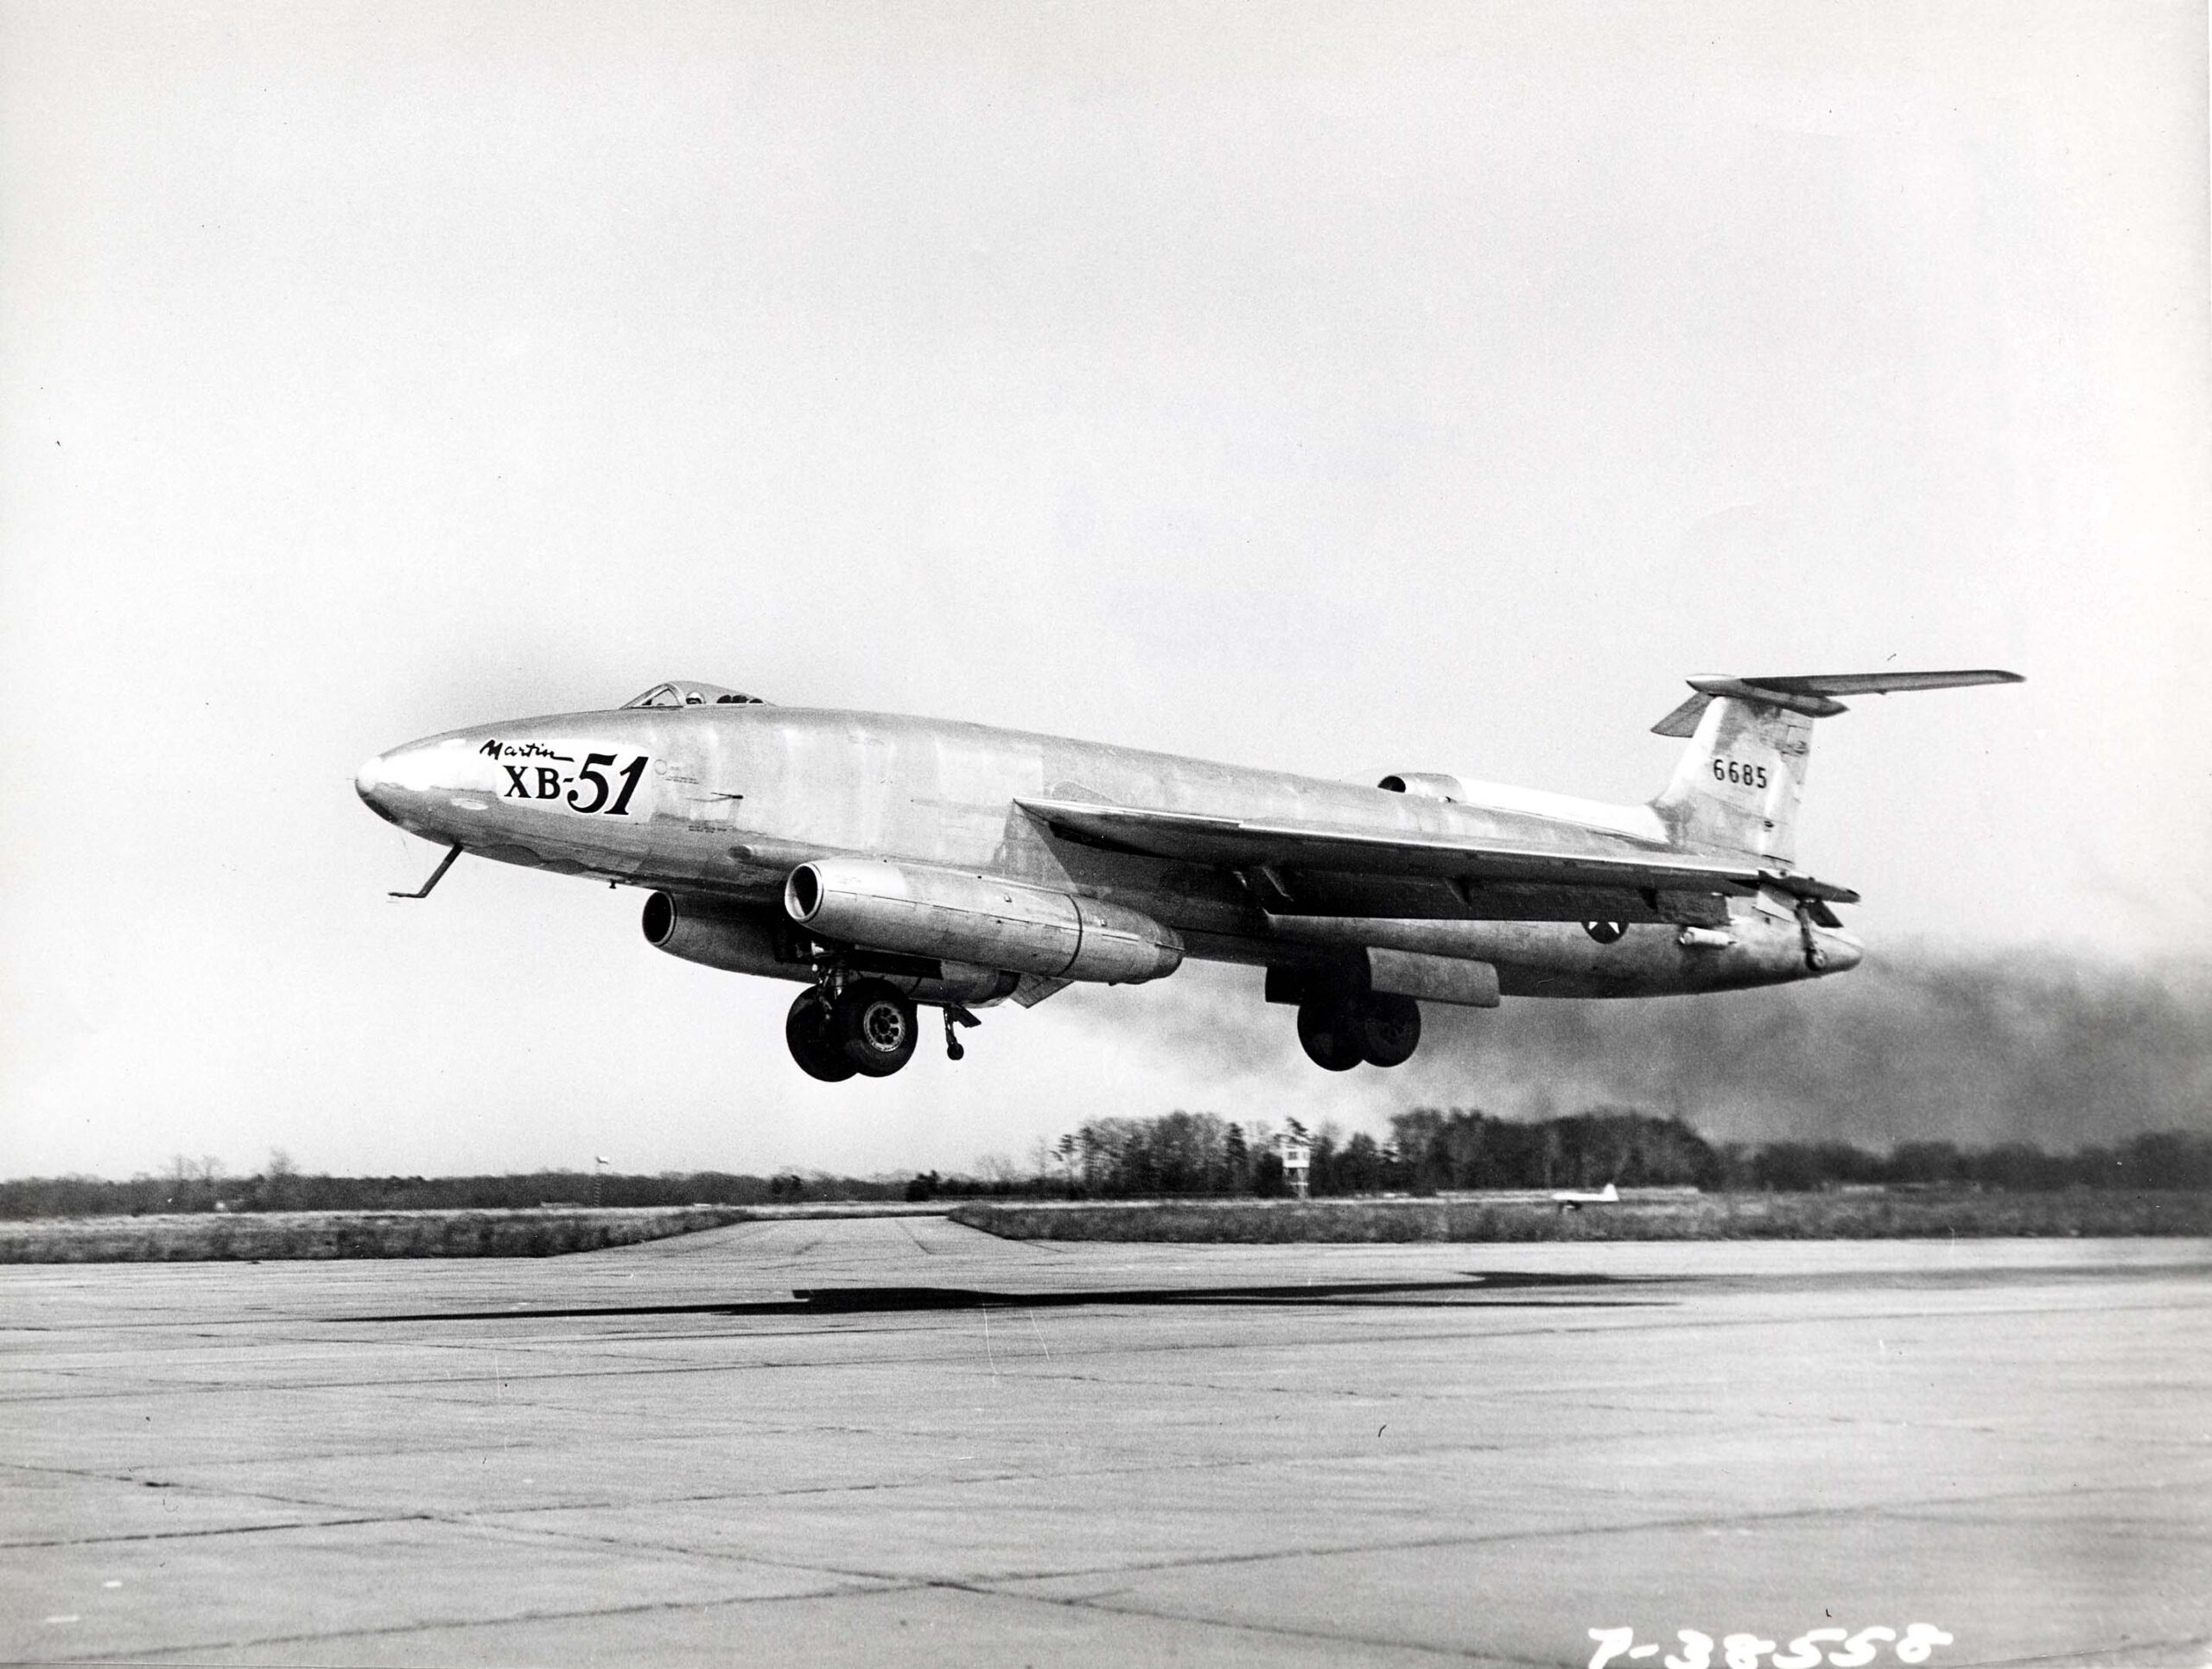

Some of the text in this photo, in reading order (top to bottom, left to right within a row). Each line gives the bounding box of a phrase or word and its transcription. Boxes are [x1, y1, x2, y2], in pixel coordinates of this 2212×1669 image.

[480, 739, 575, 762] Martin
[503, 753, 649, 815] XB-51
[1713, 759, 1767, 788] 6685
